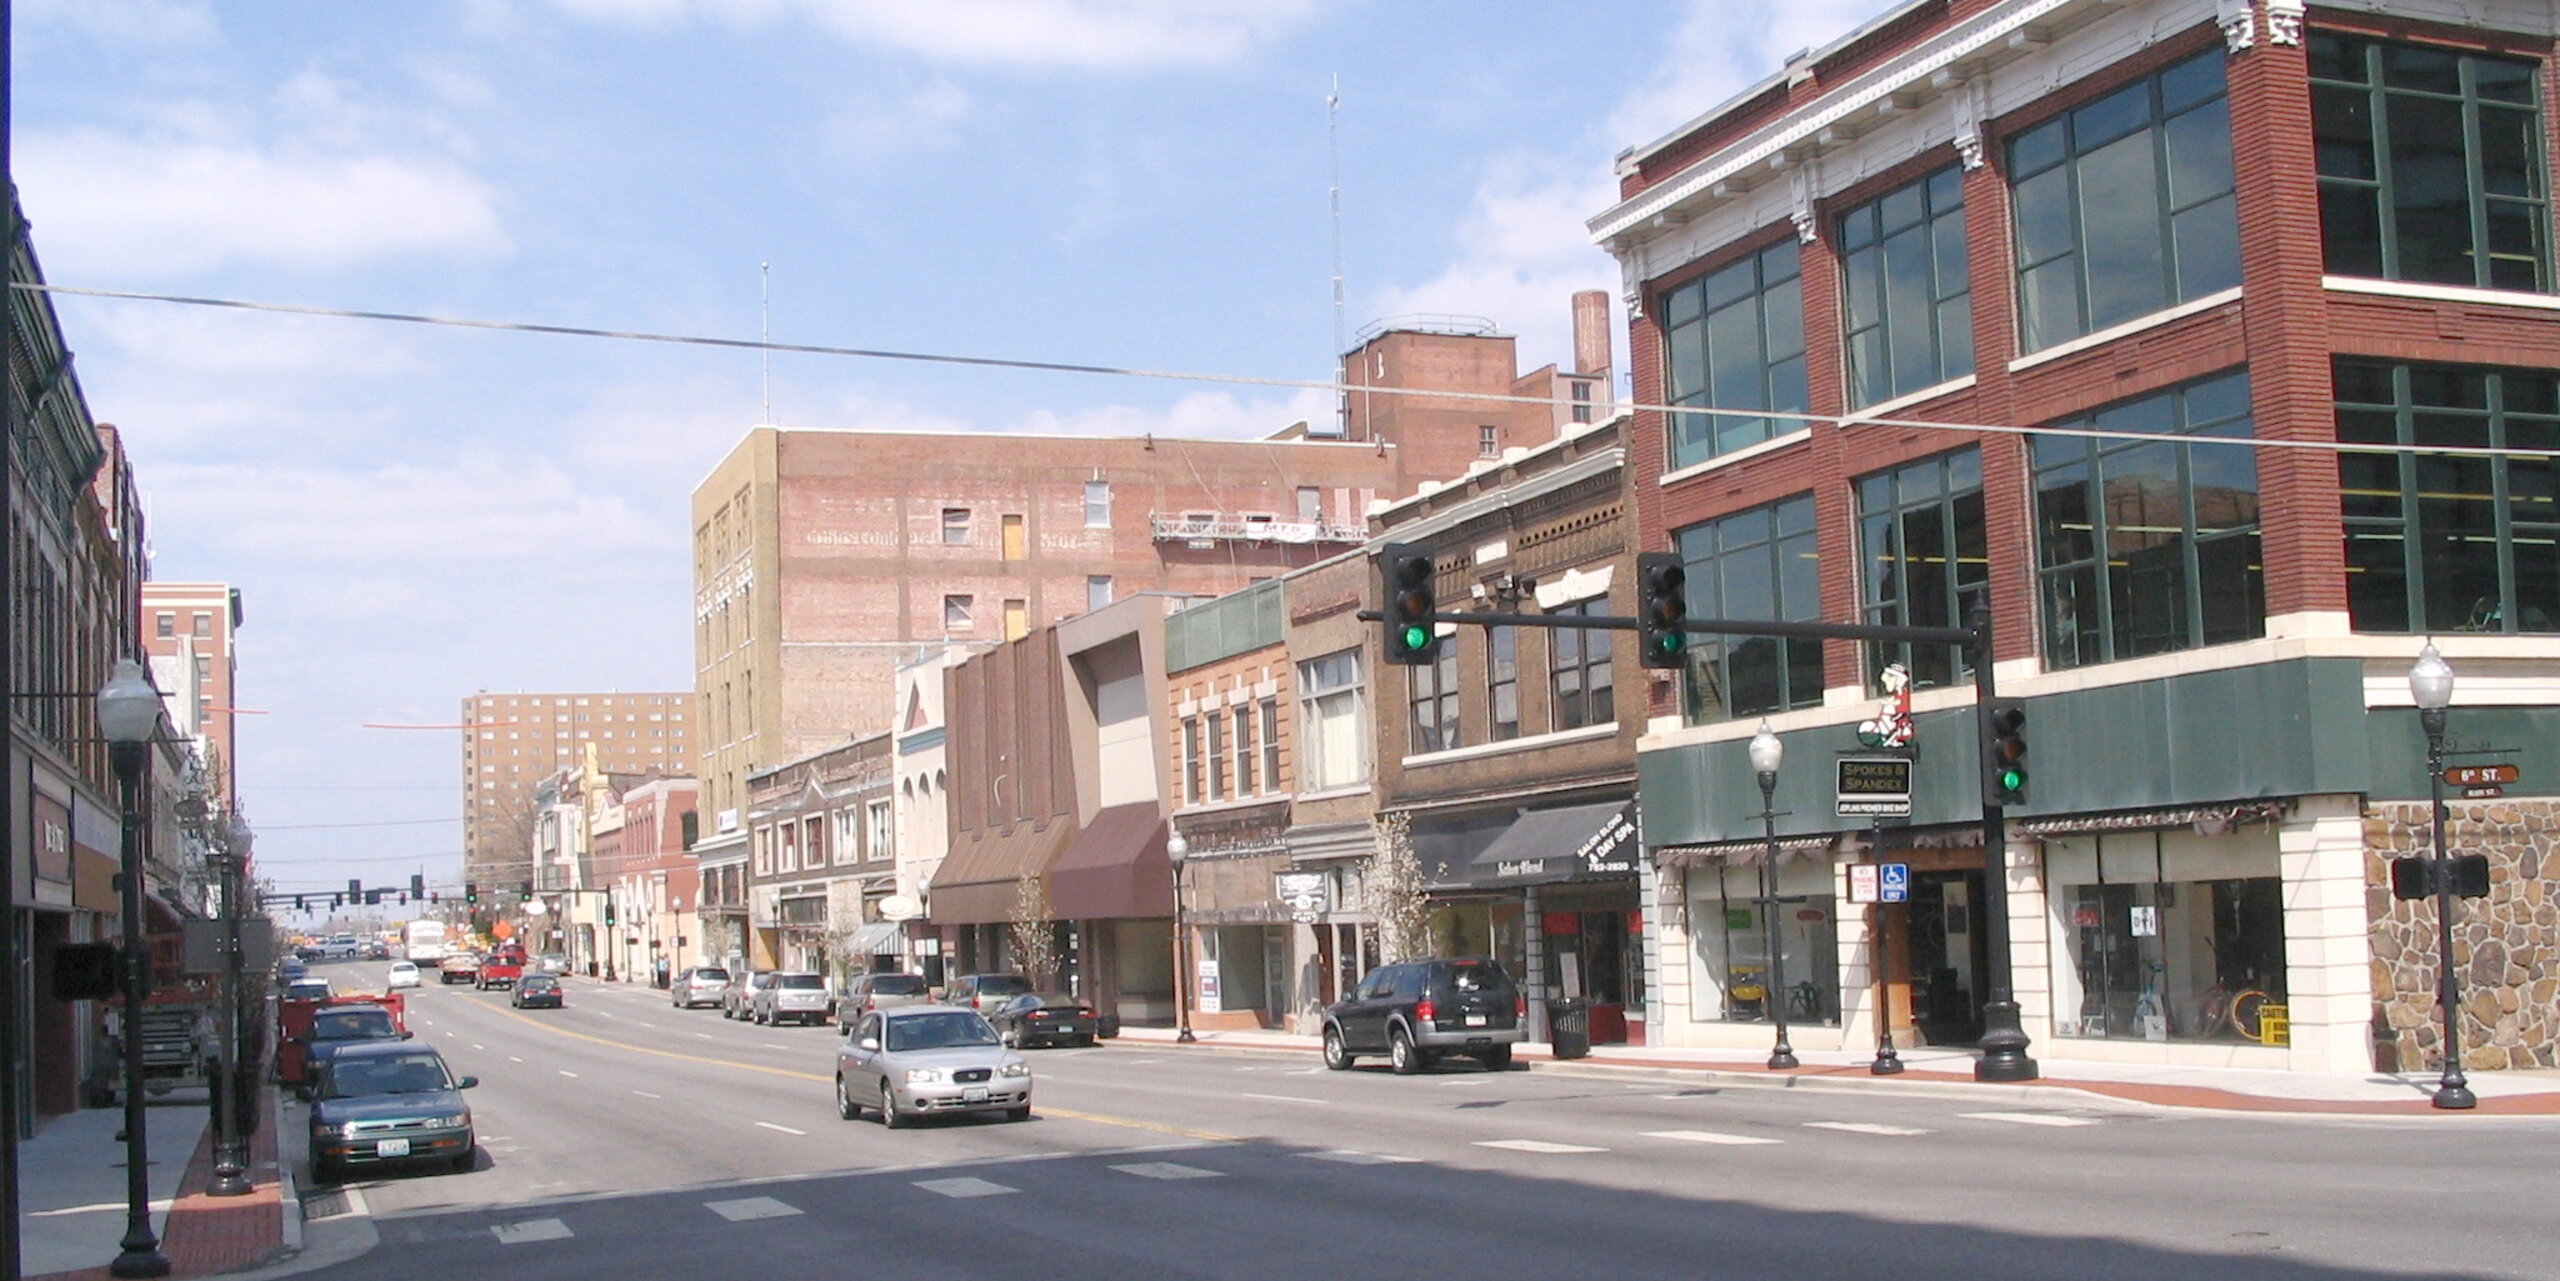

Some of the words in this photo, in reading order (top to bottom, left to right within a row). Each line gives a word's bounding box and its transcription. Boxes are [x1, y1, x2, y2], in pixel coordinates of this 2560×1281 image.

[1845, 763, 1893, 775] SPOKES
[2482, 768, 2501, 781] ST.
[1845, 777, 1903, 790] SPANDEX
[1577, 834, 1601, 858] SALON
[1596, 835, 1616, 857] DAY
[1614, 822, 1636, 842] SPA
